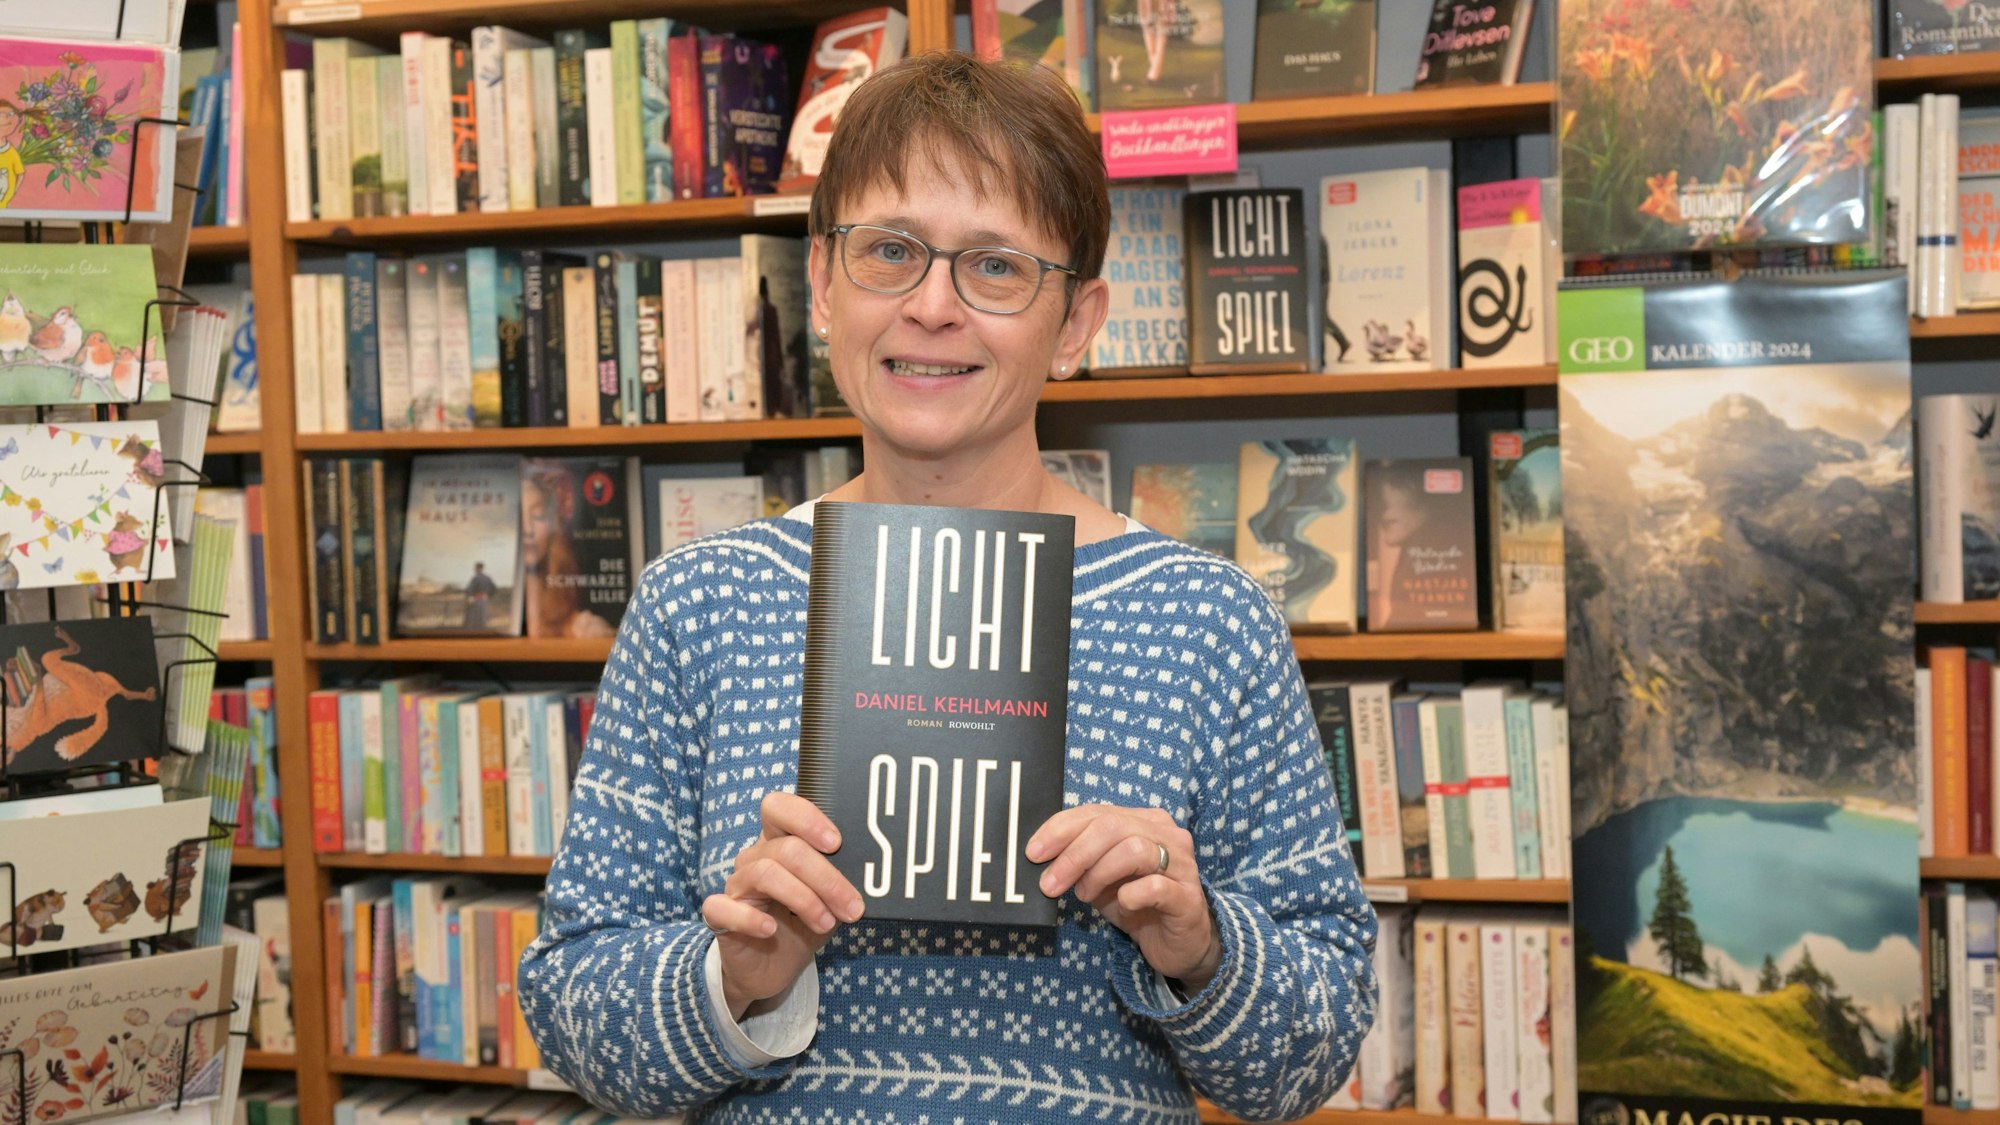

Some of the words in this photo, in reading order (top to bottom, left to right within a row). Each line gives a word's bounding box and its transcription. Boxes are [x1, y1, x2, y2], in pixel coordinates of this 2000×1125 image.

[1452, 4, 1497, 27] Tove
[1424, 22, 1511, 55] Ditlevsen
[1109, 134, 1226, 158] Buchhandlungen
[1211, 195, 1291, 258] LICHT
[1687, 219, 1736, 237] 2024
[1119, 234, 1179, 257] PAAR
[1109, 260, 1181, 282] RAGEN
[1336, 264, 1405, 283] Lorenz
[1133, 286, 1162, 308] AN
[1216, 290, 1296, 356] SPIEL
[638, 303, 658, 384] DEMUT
[1568, 336, 1634, 364] GEO
[1651, 340, 1764, 362] KALENDER
[1768, 342, 1812, 360] 2024
[434, 491, 505, 506] VATERS
[418, 510, 470, 523] HAUS
[599, 558, 626, 572] DIE
[546, 573, 627, 588] SCHWARZE
[590, 589, 627, 604] LILIE
[871, 525, 1045, 672] LICHT
[855, 692, 927, 712] DANIEL
[934, 696, 1048, 718] KEHLMANN
[907, 719, 943, 728] ROMAN
[949, 721, 995, 731] ROWOHLT
[1357, 696, 1370, 744] HANYA
[1374, 695, 1391, 785] YANAGIHARA
[1361, 758, 1376, 809] WENIG
[864, 754, 1025, 904] SPIEL
